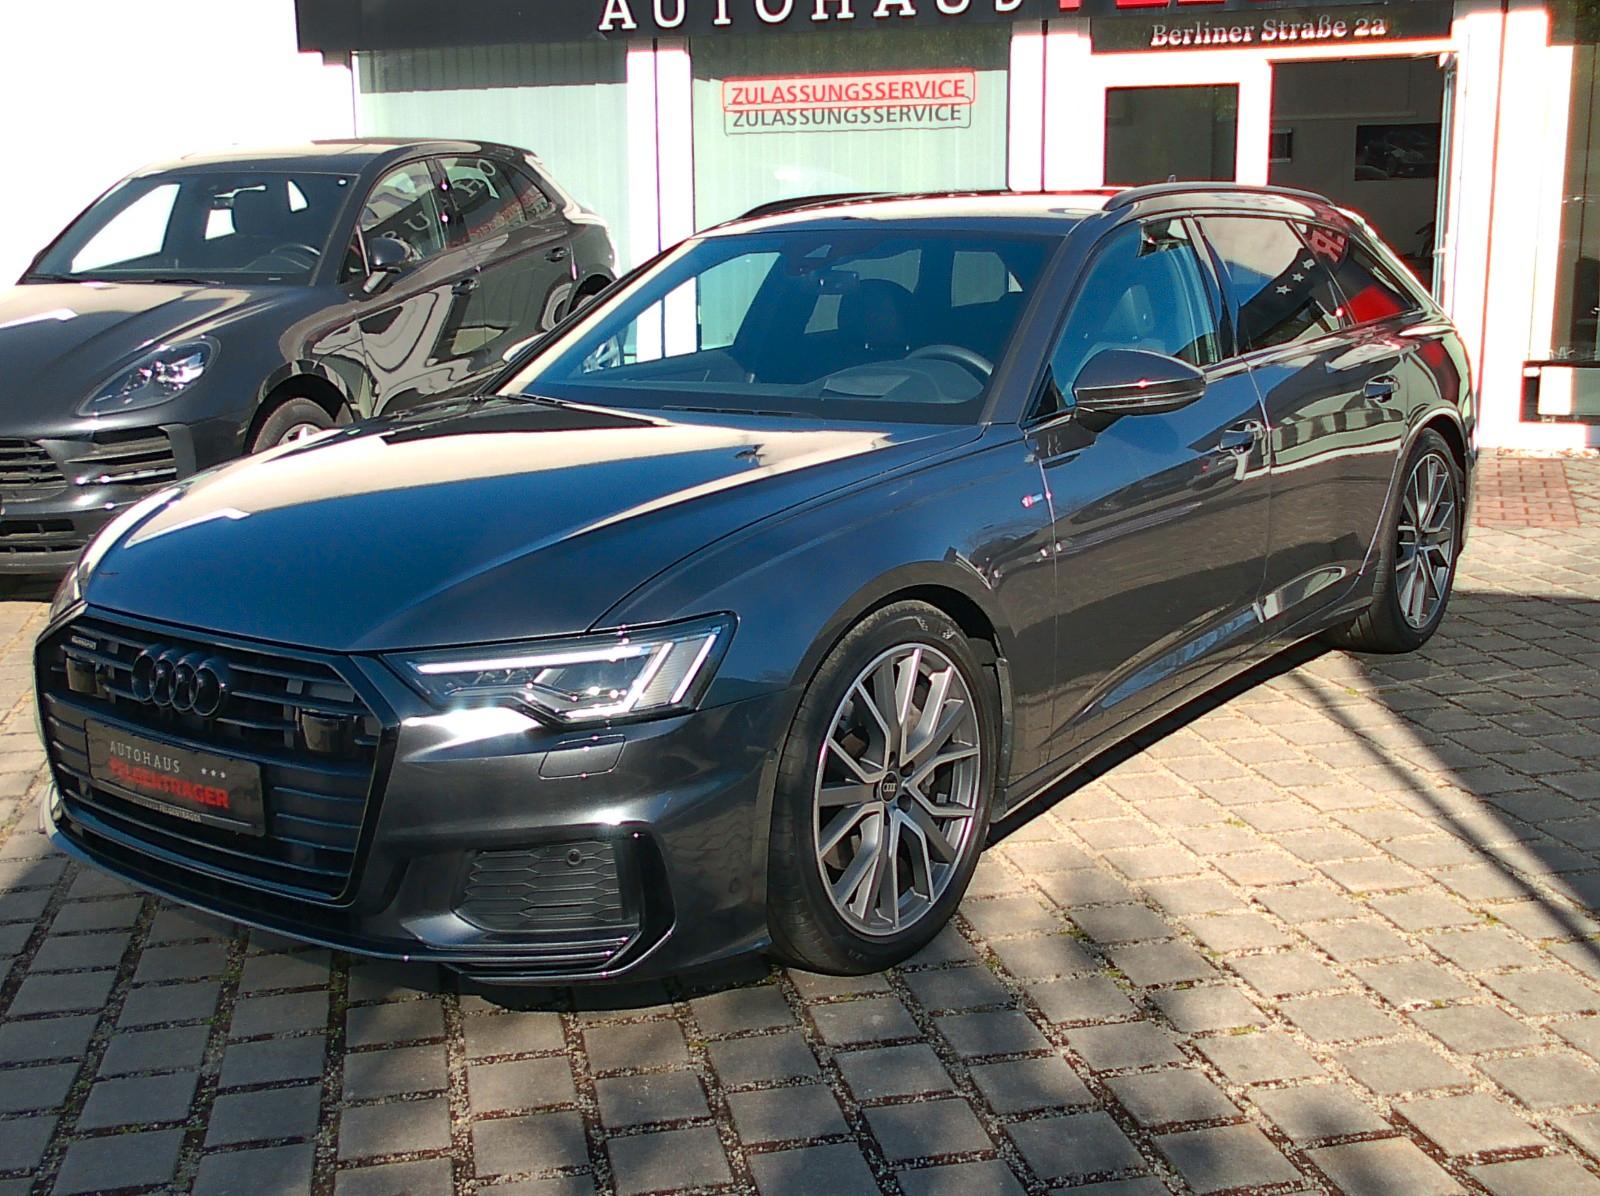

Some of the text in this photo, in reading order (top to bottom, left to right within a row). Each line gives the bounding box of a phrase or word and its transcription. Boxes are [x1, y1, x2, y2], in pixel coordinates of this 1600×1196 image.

[598, 0, 1024, 30] AUTOH
[1150, 14, 1387, 47] Berliner Straße 2a
[731, 79, 966, 105] ZULASSUNGSSERVICE
[732, 104, 962, 128] ZULASSUNGSSERVICE
[109, 740, 181, 774] AUTOHAUS
